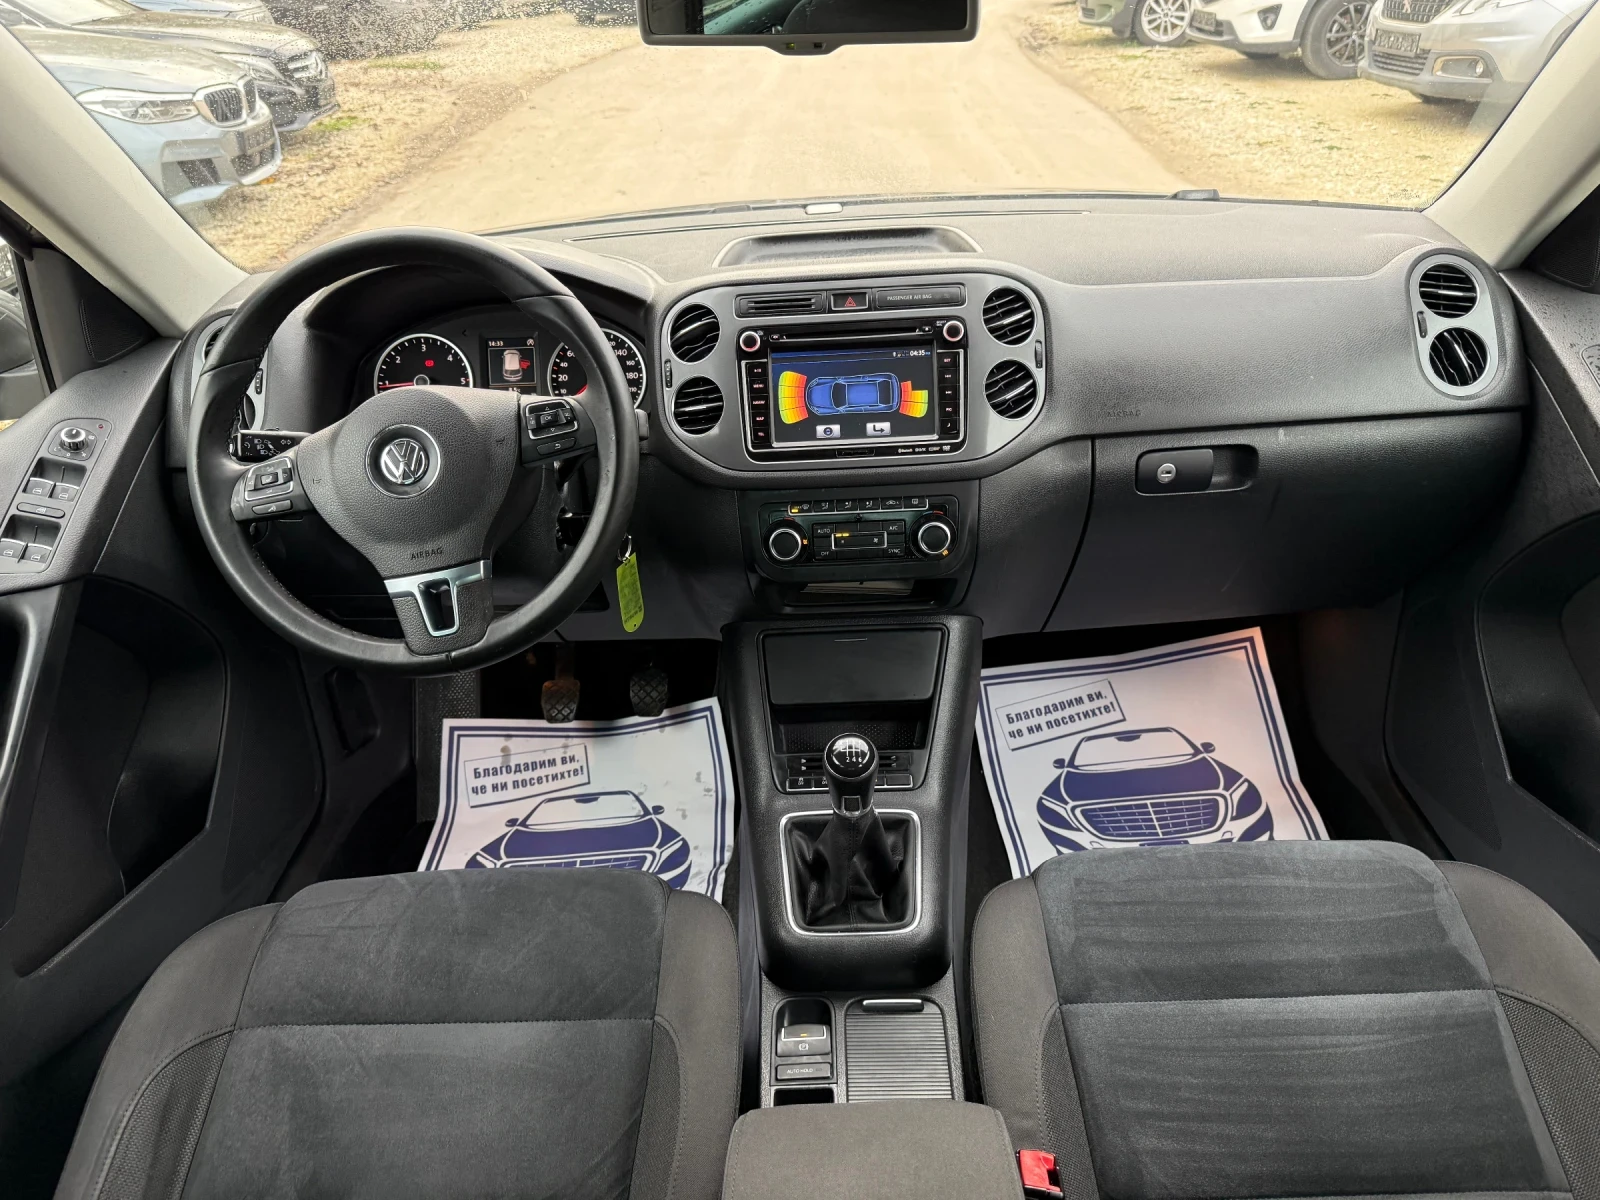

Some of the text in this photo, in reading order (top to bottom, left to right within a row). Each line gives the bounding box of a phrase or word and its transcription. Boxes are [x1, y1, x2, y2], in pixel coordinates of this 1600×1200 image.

[421, 344, 426, 352] 3
[395, 356, 401, 364] 2
[447, 354, 453, 362] 4
[558, 374, 568, 382] 20
[410, 546, 443, 560] AIRBAG
[1005, 695, 1085, 724] Благодарим
[1008, 701, 1116, 740] че ни посетихте!
[473, 757, 557, 779] Благодарим
[471, 765, 585, 796] че ни посетихте!
